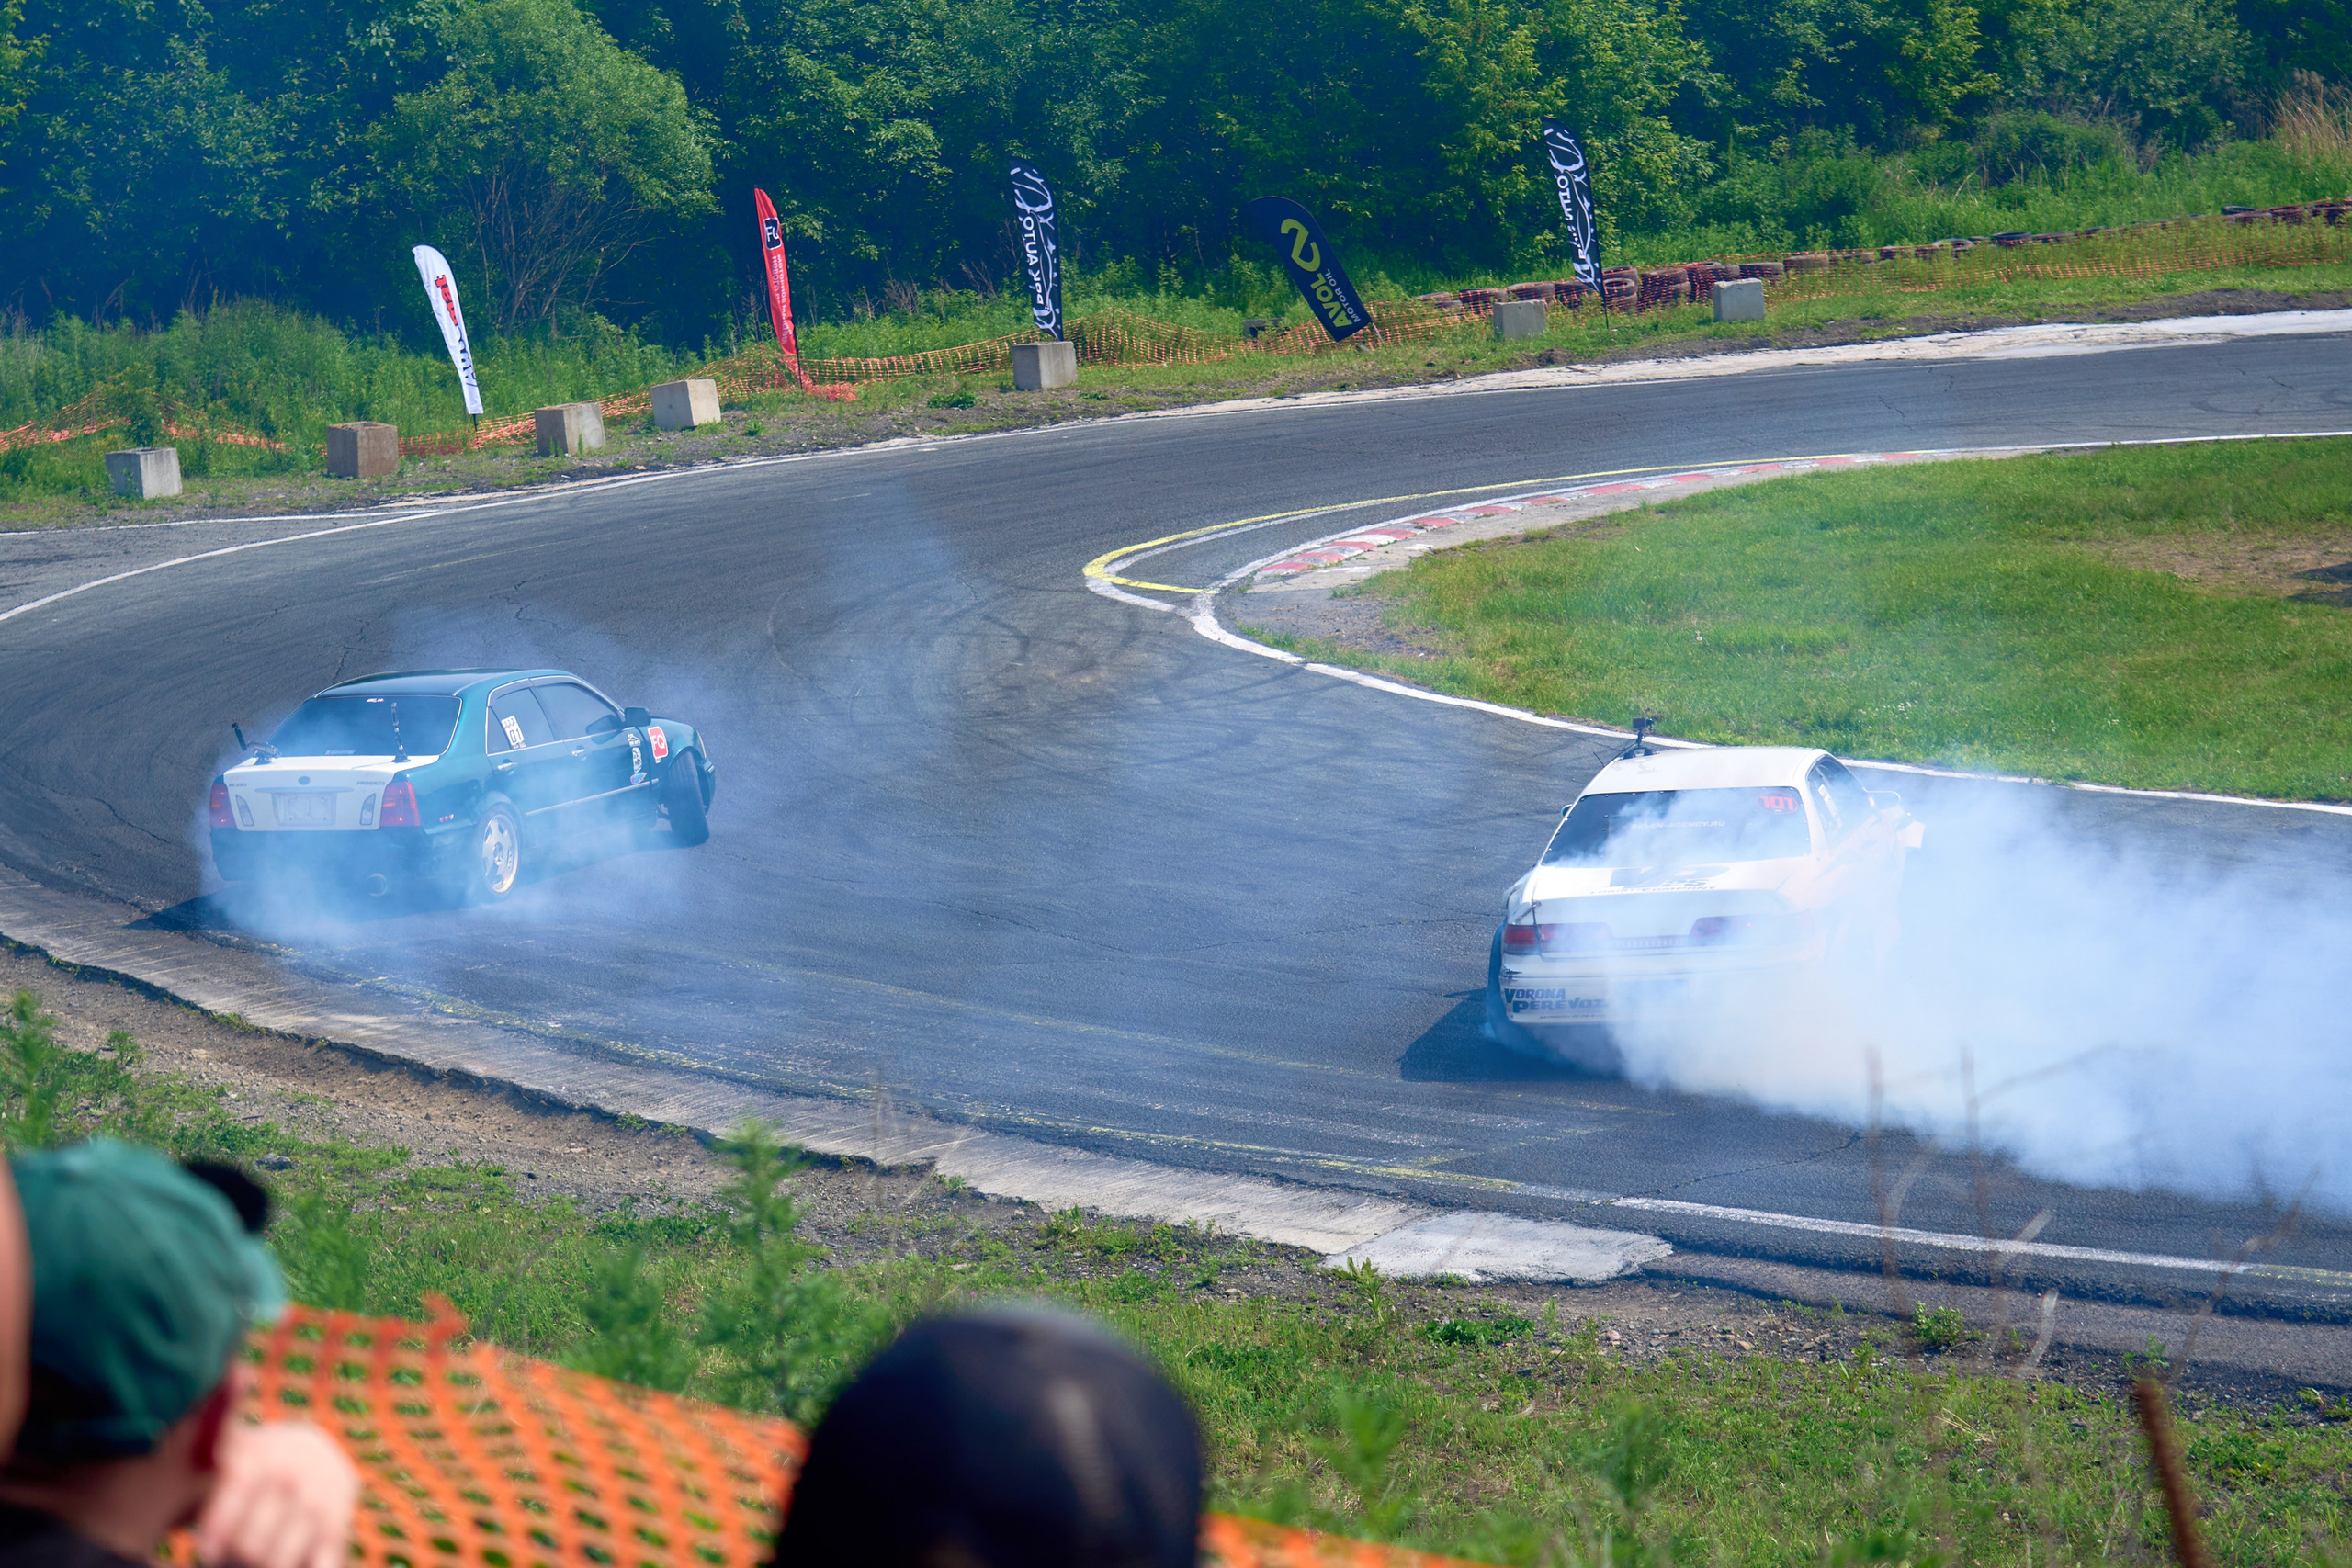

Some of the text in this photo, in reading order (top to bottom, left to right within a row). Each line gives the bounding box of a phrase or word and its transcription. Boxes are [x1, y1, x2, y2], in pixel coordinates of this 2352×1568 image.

[1310, 273, 1352, 328] AVOL
[1324, 268, 1361, 322] MOTOR OIL
[651, 734, 665, 750] FQ
[1759, 795, 1794, 811] 101
[1504, 988, 1566, 1003] VORONA
